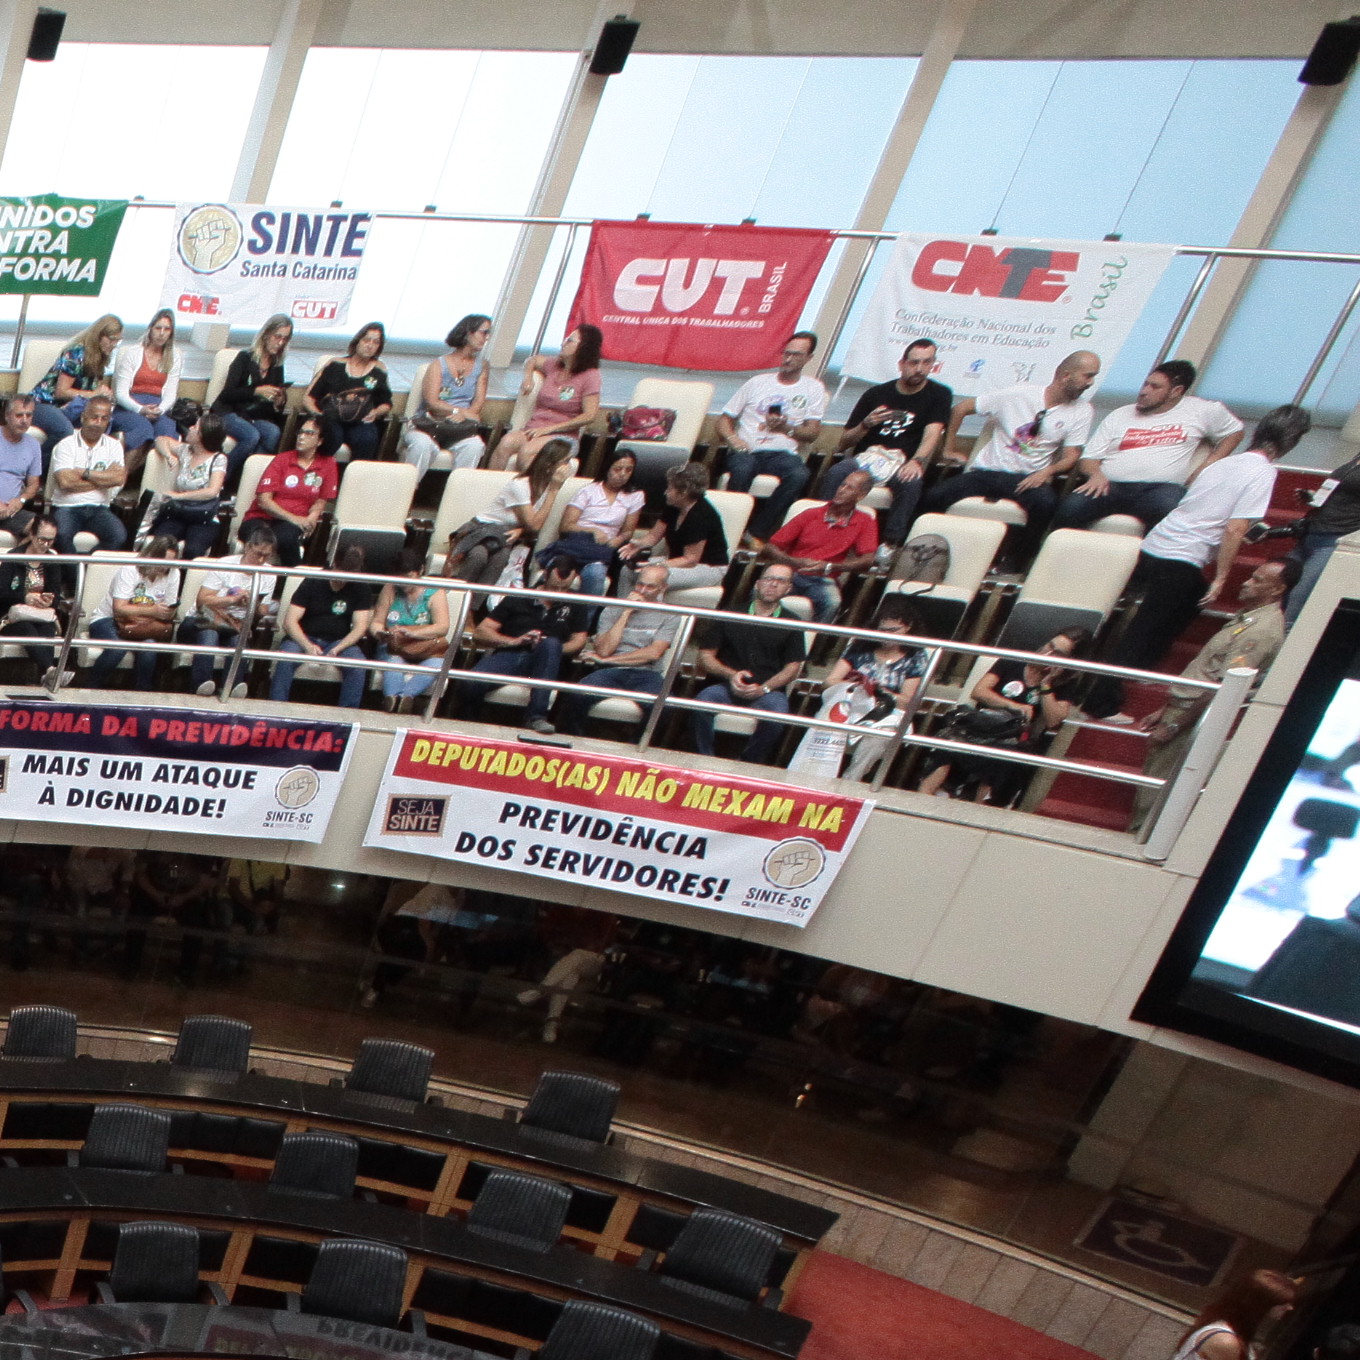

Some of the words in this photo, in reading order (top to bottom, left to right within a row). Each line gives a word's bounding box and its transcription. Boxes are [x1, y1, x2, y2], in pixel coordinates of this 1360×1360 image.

[247, 211, 372, 258] SINTE
[240, 259, 287, 278] Santa
[291, 260, 358, 281] Catarina
[613, 257, 766, 315] CUT
[758, 261, 789, 313] BRASIL
[911, 240, 1080, 303] CNTE
[177, 293, 220, 315] CNTE
[291, 301, 337, 319] CUT
[1070, 255, 1129, 340] Brasil
[890, 321, 968, 343] Trabalhadores
[970, 334, 989, 344] em
[991, 332, 1050, 348] Educação
[895, 308, 974, 329] Confederação
[976, 318, 1031, 334] Nacional
[1032, 322, 1057, 335] dos
[101, 715, 139, 738] DA
[148, 718, 343, 754] PREVIDÊNCIA:
[21, 754, 91, 778] MAIS
[99, 759, 143, 782] UM
[151, 763, 258, 791] ATAQUE
[410, 739, 611, 796] DEPUTADOS(AS)
[616, 769, 679, 804] NÃO
[682, 783, 796, 825] MEXAM
[796, 800, 845, 834] NA
[37, 780, 55, 806] À
[65, 790, 227, 819] DIGNIDADE!
[265, 810, 314, 824] SINTE-SC
[396, 800, 436, 817] SEJA
[388, 813, 441, 833] SINTE
[499, 801, 709, 860] PREVIDÊNCIA
[454, 831, 514, 861] DOS
[524, 847, 731, 902] SERVIDORES!
[746, 887, 811, 910] SINTE-SC
